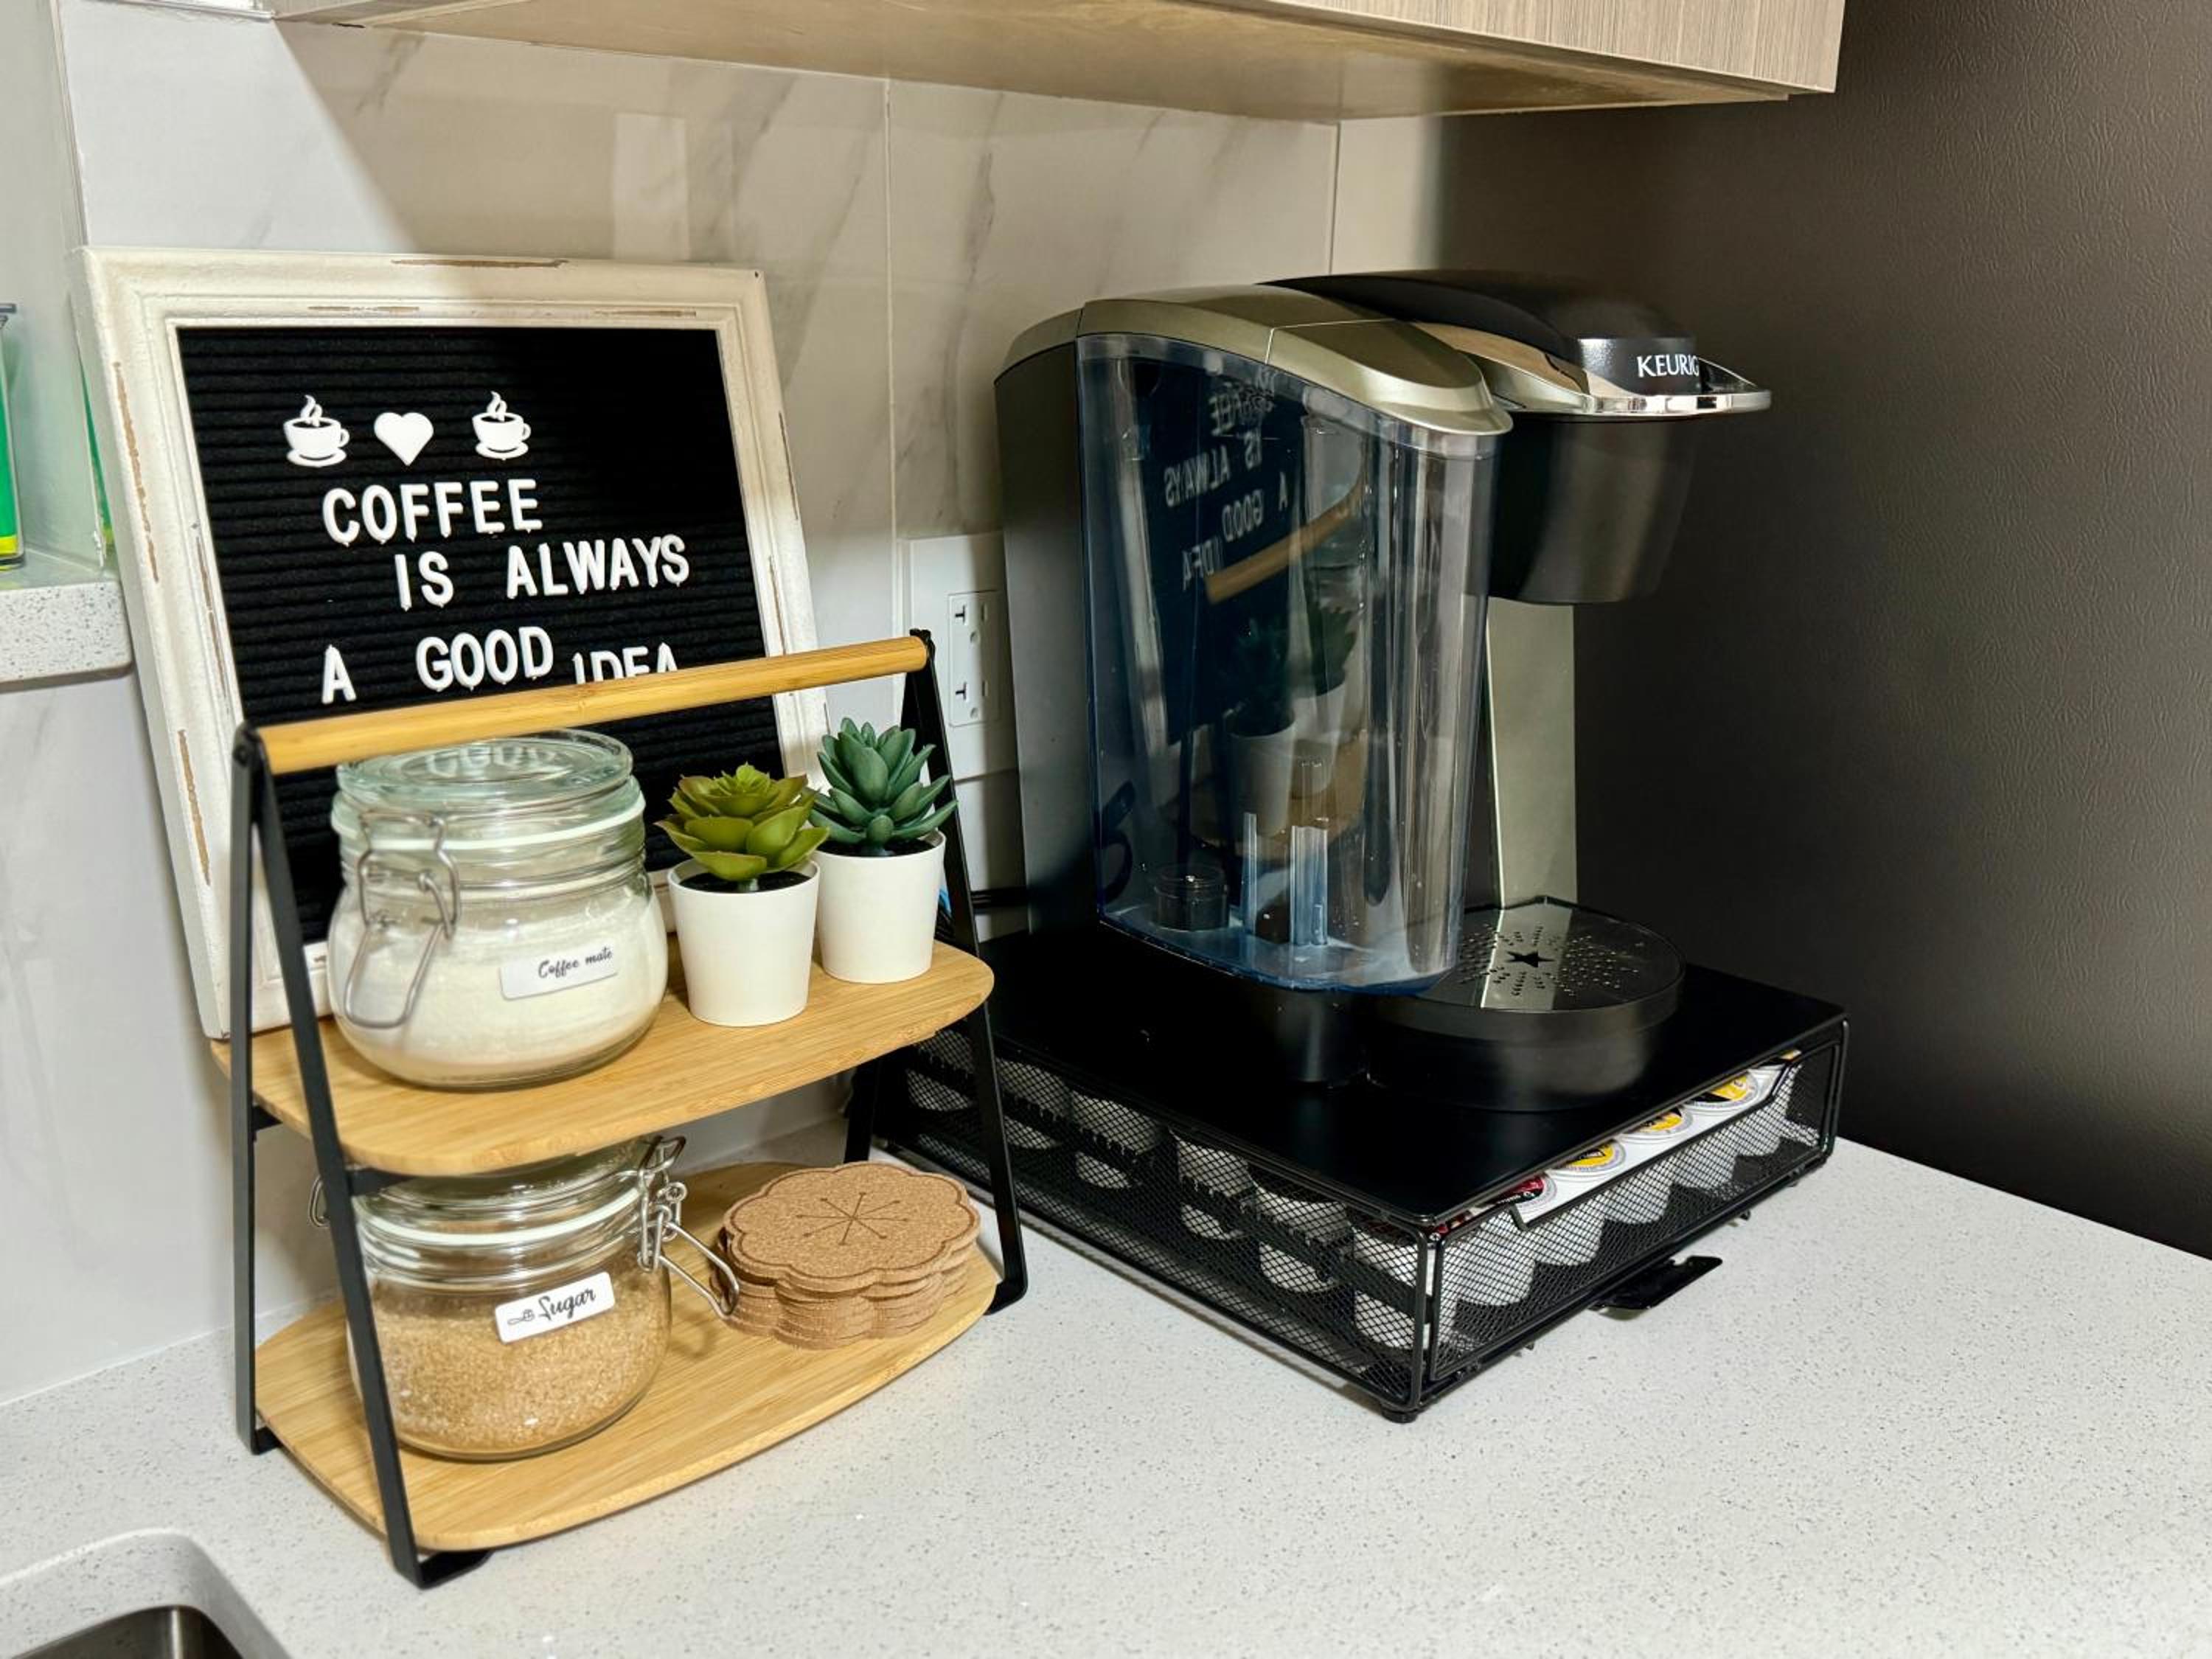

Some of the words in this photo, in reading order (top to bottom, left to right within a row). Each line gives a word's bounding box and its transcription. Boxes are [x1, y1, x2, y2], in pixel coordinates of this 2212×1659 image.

[1636, 353, 1700, 378] KEURIG
[321, 478, 543, 547] COFFEE
[394, 551, 454, 611] IS
[506, 533, 690, 600] ALWAYS
[321, 644, 357, 704] A
[415, 625, 554, 692] GOOD
[538, 959, 580, 979] Coffee
[585, 945, 613, 963] mate
[538, 1287, 597, 1321] Sugar
